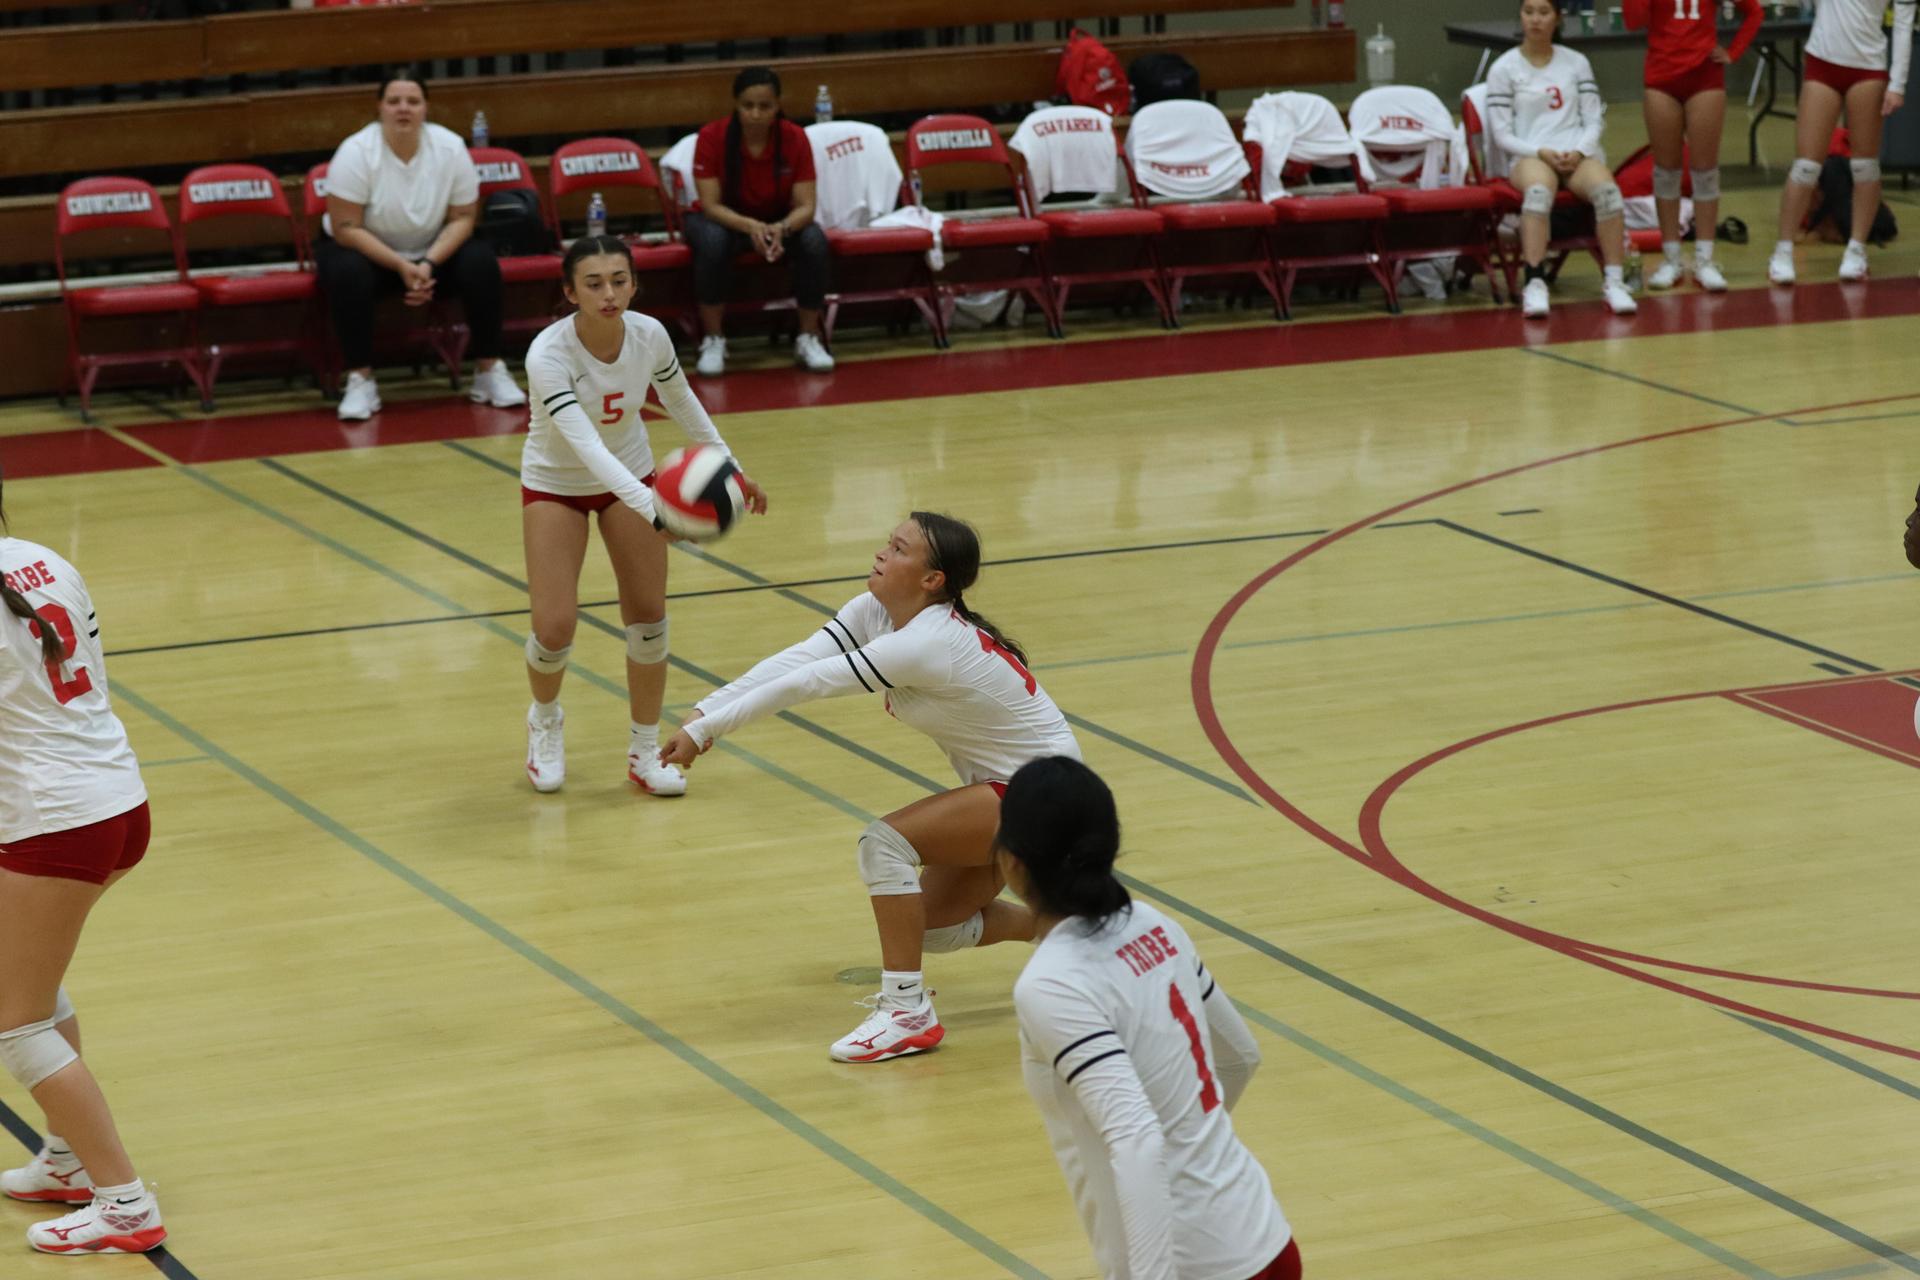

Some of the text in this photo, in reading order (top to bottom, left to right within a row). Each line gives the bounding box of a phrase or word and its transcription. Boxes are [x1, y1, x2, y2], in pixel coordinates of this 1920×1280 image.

[1546, 86, 1564, 110] 3
[915, 128, 992, 151] CHOWCHILLA
[560, 152, 640, 176] CHOWCHILLA
[600, 392, 624, 425] 5
[3, 560, 56, 594] RIBE
[28, 603, 93, 705] 2
[1115, 926, 1178, 977] TRIBE
[1169, 982, 1221, 1114] 1
